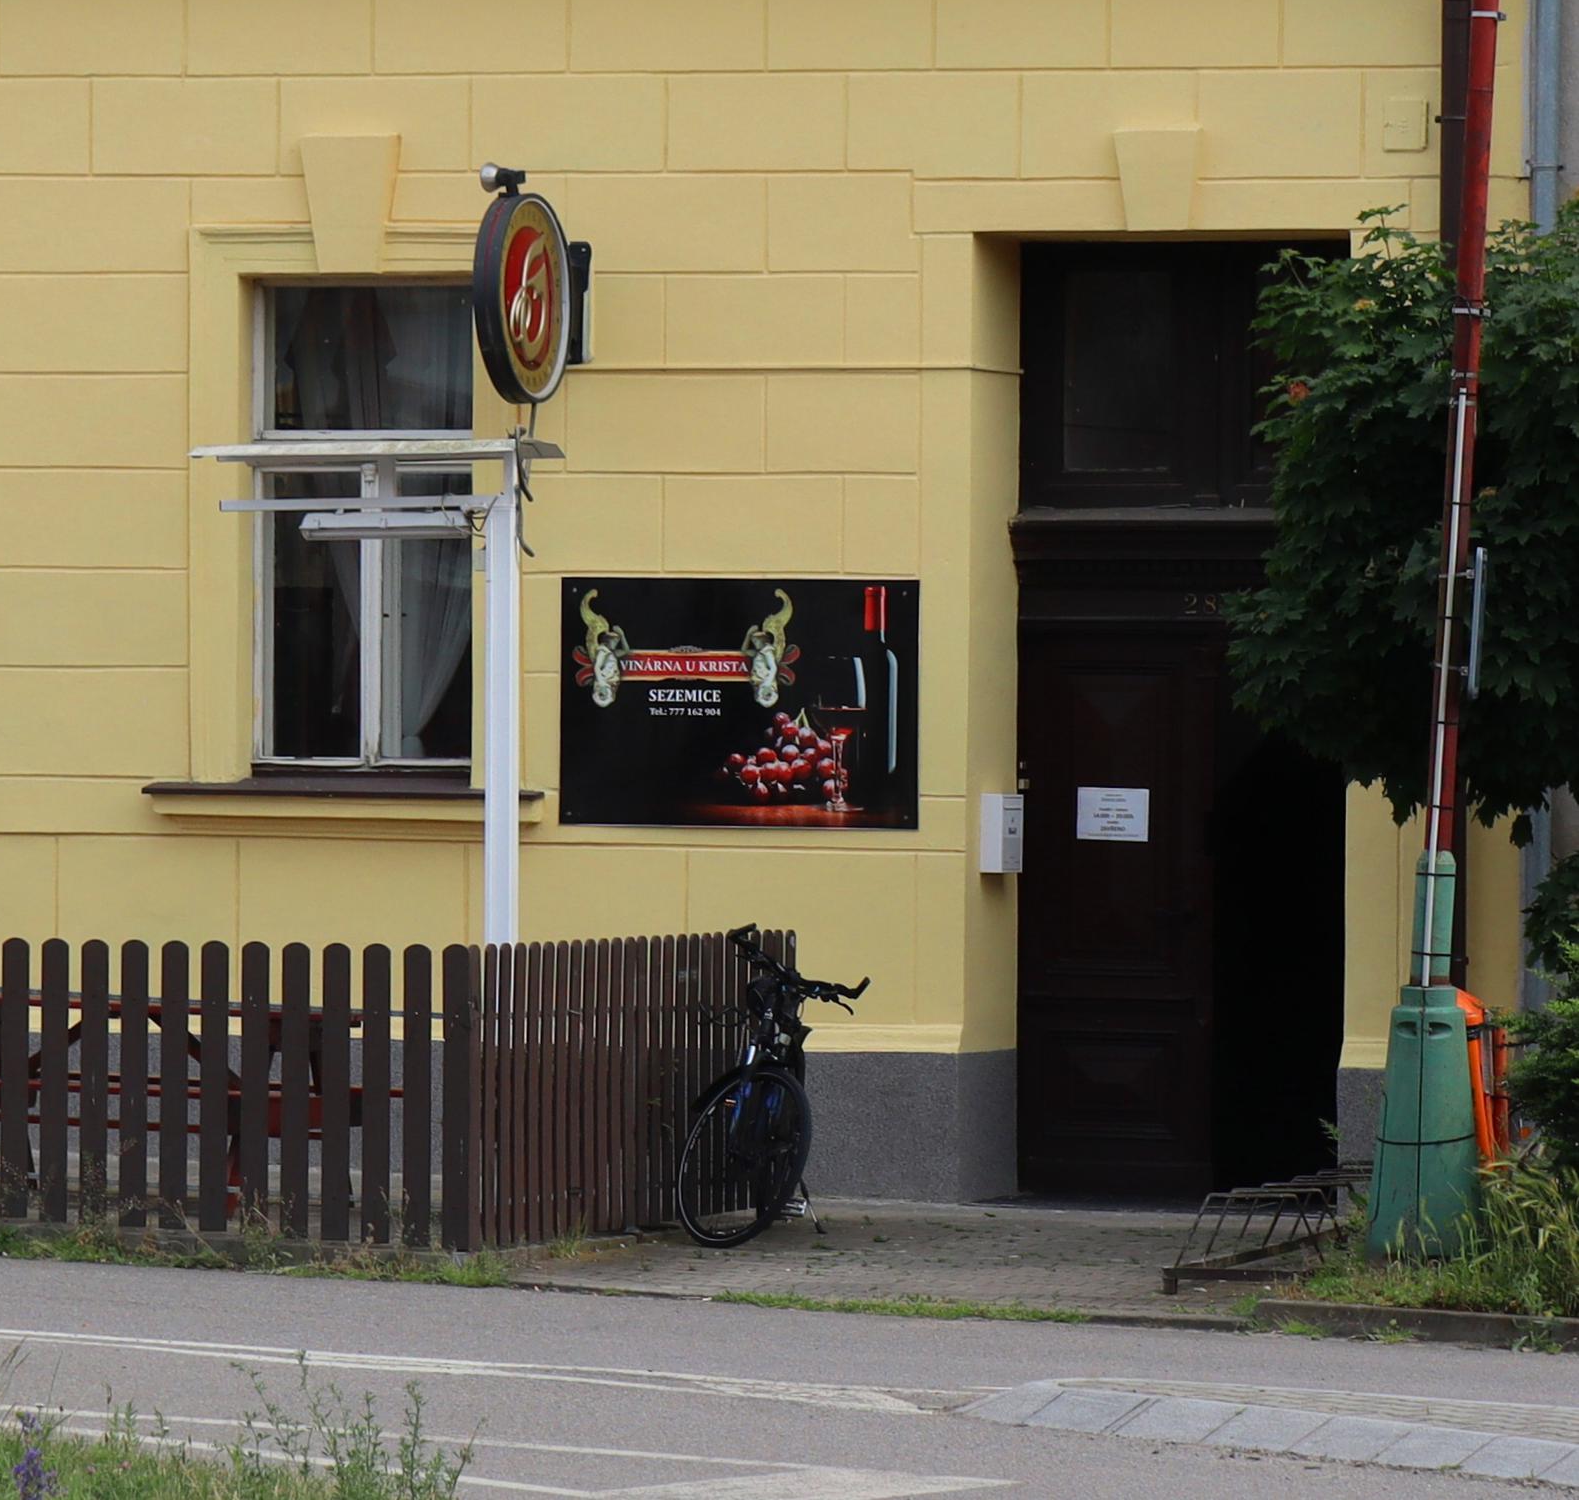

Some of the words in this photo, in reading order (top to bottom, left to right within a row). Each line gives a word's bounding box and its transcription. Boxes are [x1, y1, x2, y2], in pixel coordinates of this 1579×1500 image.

[620, 657, 682, 672] VINÁRNA
[685, 660, 696, 672] U
[699, 660, 749, 673] KRISTA
[648, 688, 722, 703] SEZEMICE
[668, 707, 685, 716] 777
[688, 707, 703, 717] 162
[705, 707, 721, 717] 904
